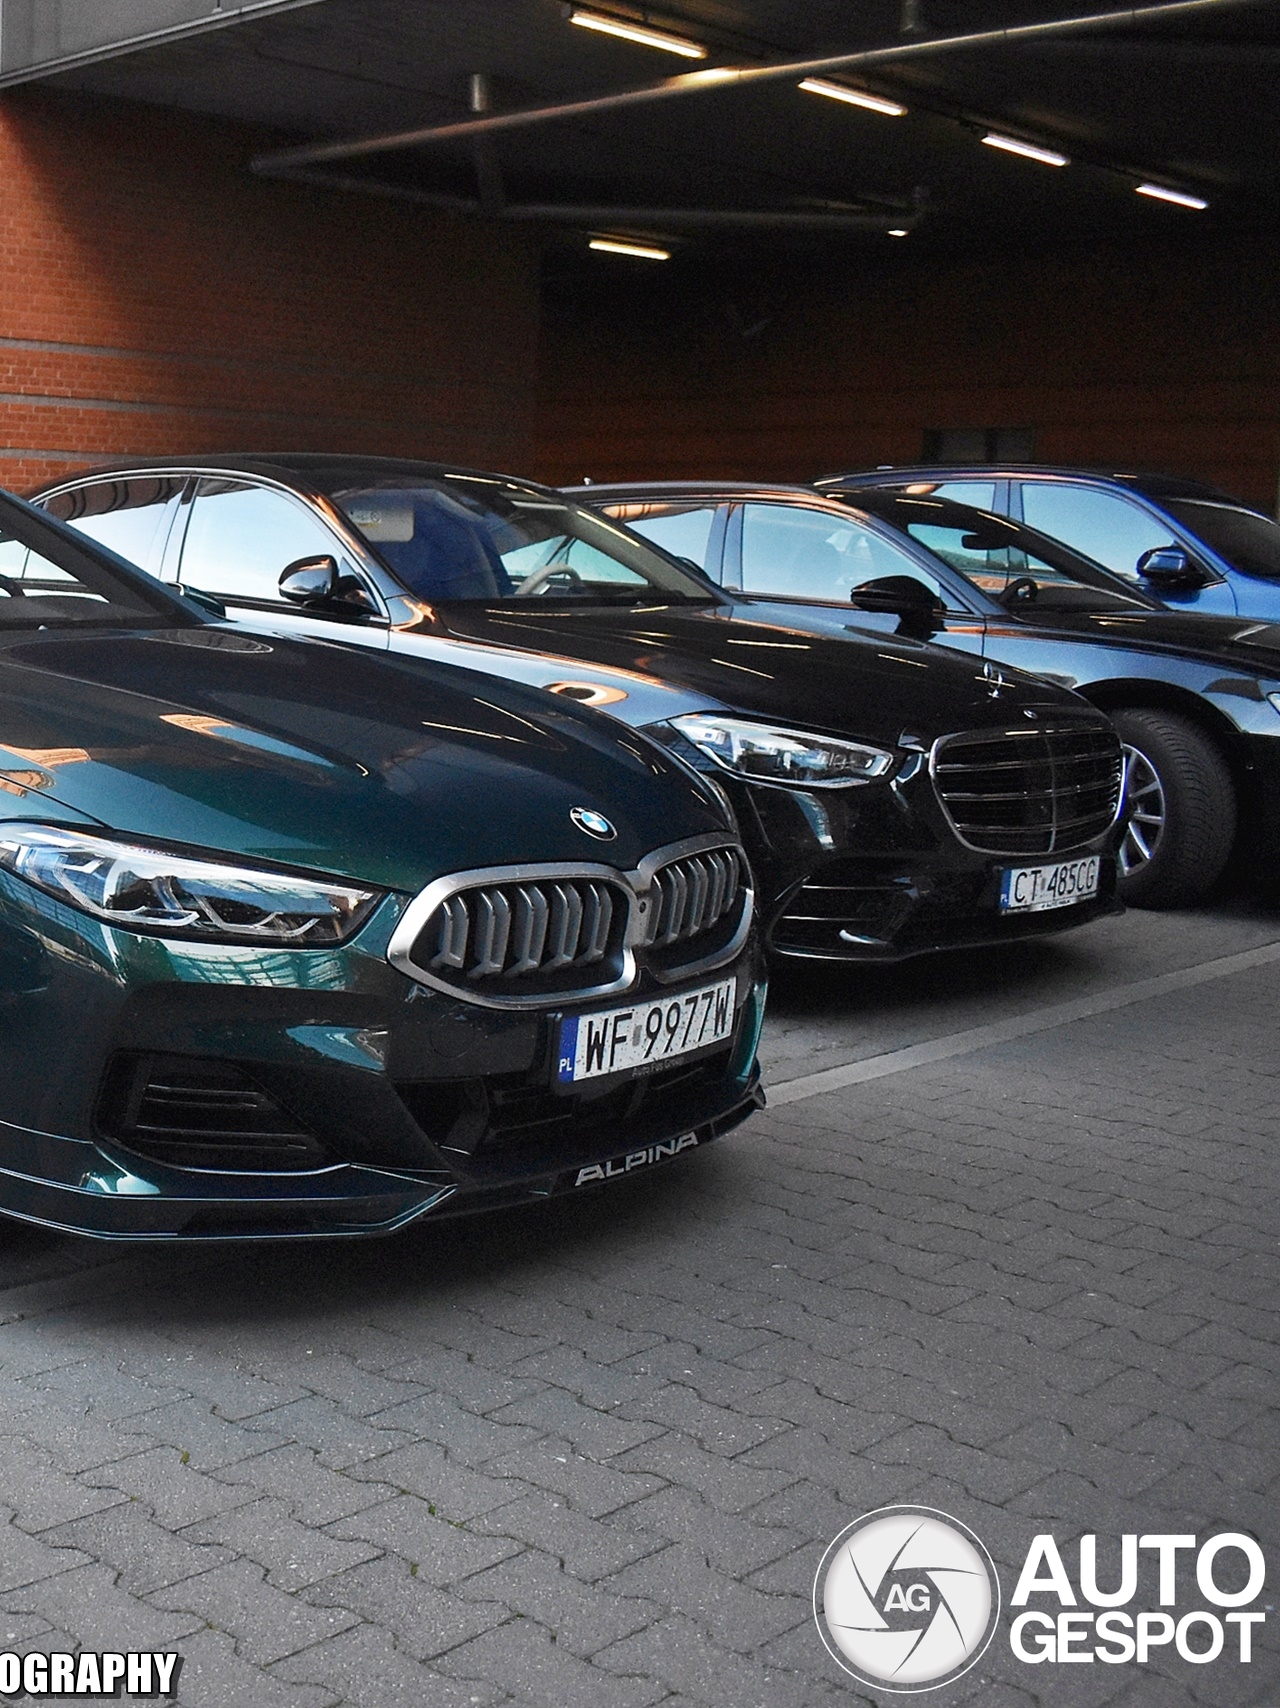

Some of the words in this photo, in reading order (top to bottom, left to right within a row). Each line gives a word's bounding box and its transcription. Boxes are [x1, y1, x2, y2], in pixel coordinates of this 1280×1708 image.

[1014, 870, 1042, 903] CT
[1047, 860, 1096, 898] 485CG
[585, 1013, 633, 1072] WF
[642, 985, 731, 1058] 9977W
[559, 1057, 572, 1073] PL
[574, 1131, 700, 1187] ALPINA
